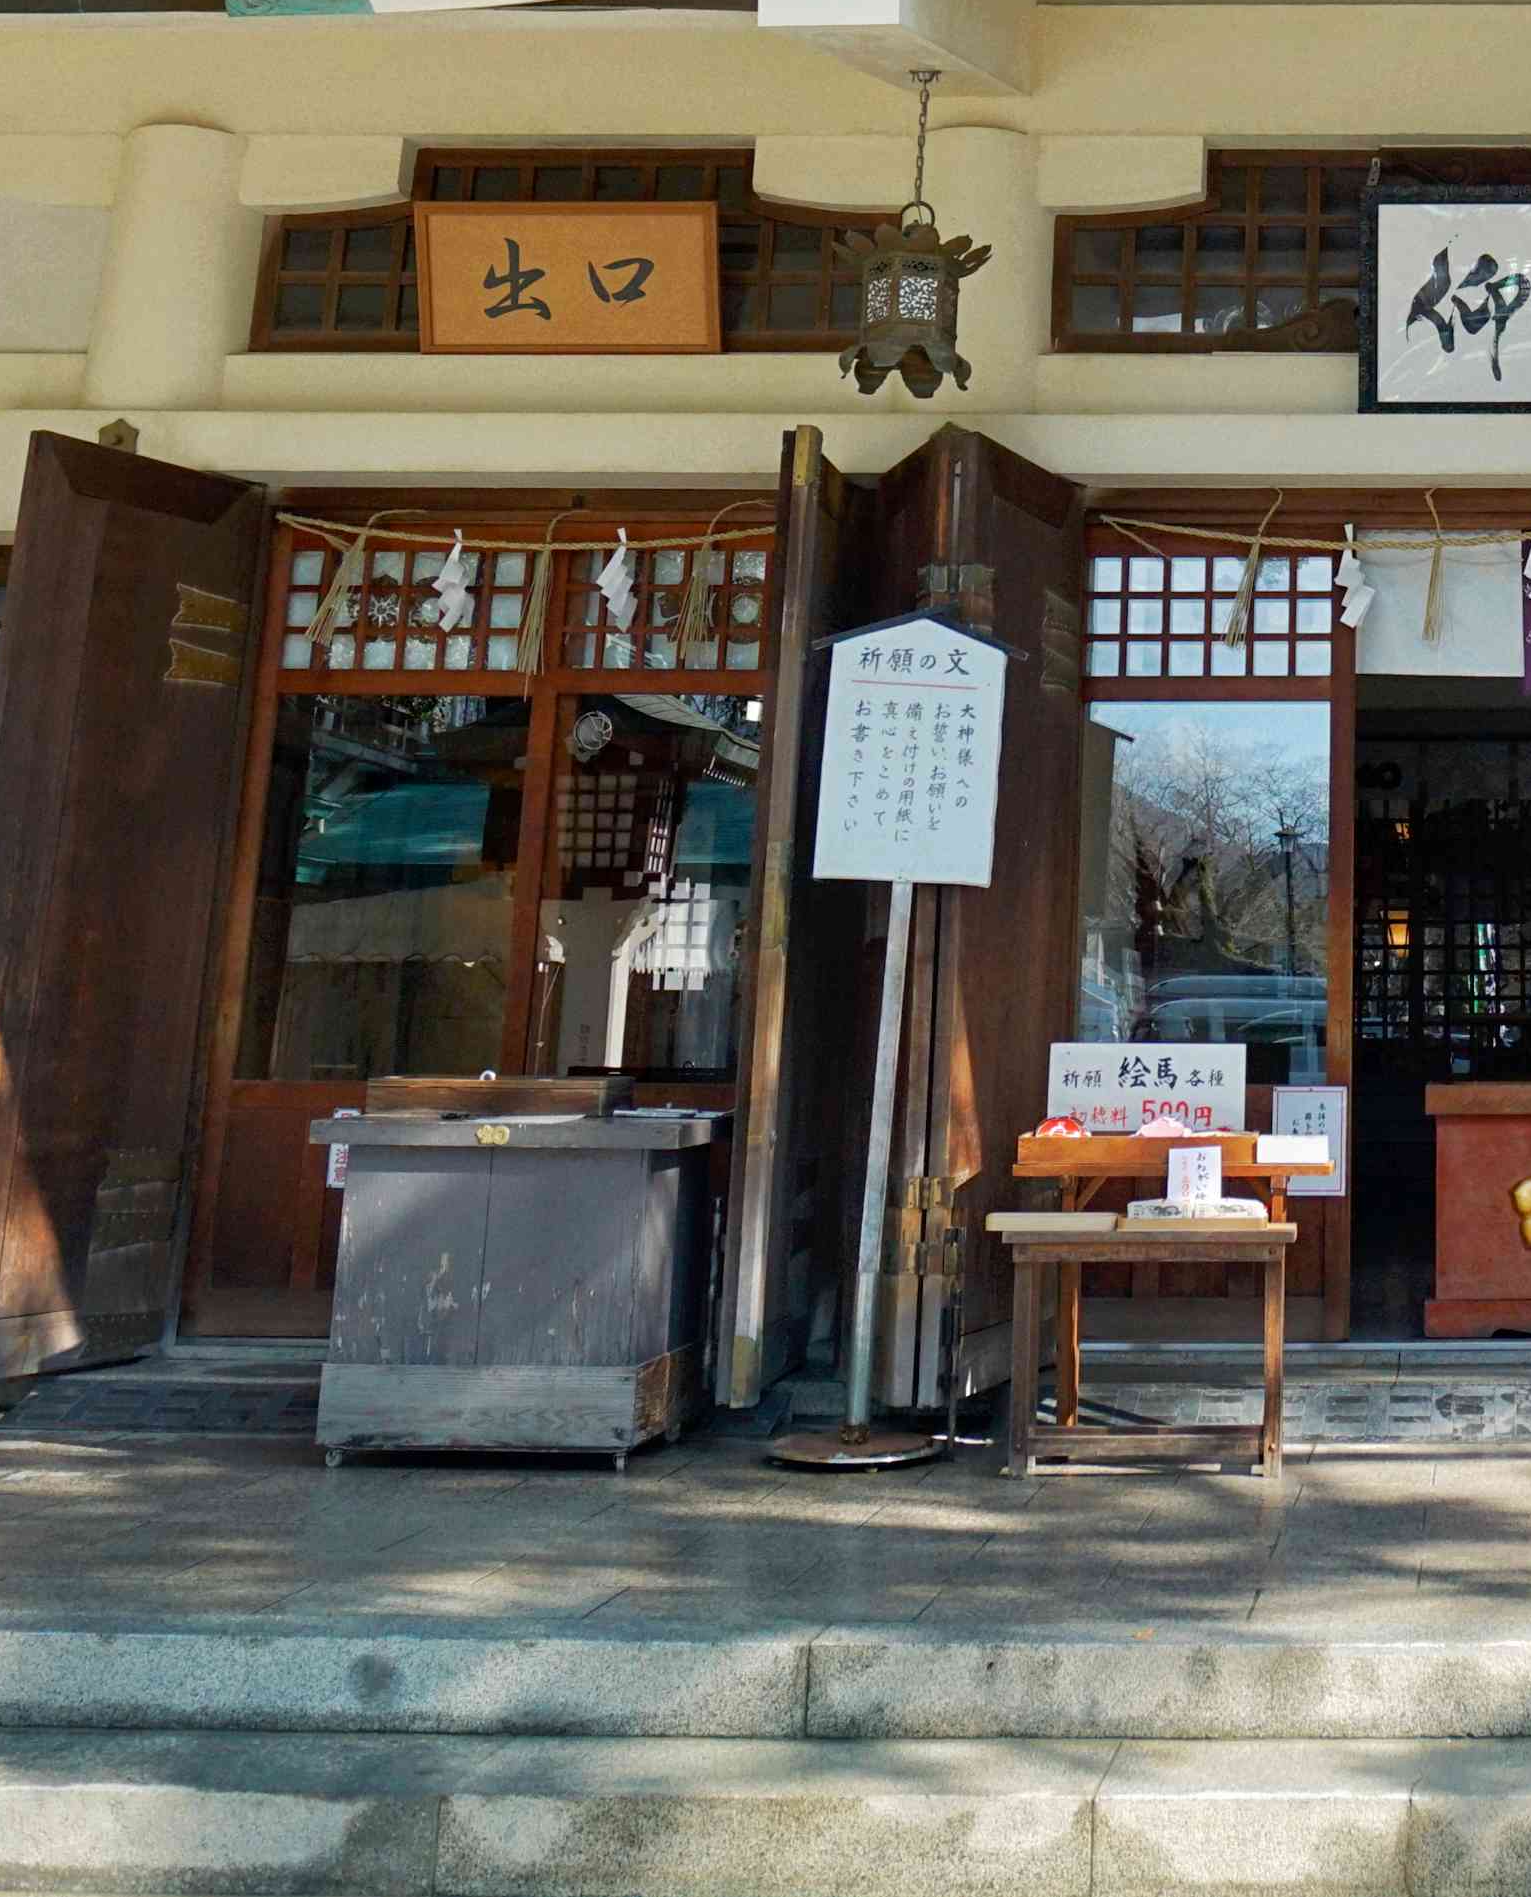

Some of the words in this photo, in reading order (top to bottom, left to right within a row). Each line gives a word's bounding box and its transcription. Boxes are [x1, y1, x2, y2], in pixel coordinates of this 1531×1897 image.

[483, 238, 654, 320] 出口
[858, 648, 970, 676] 祈願の文
[844, 700, 871, 832] お書き下さい
[873, 702, 899, 826] 真心をこめて
[894, 702, 925, 842] 備え付けの用紙に
[955, 703, 977, 808] 大神様への
[1062, 1068, 1102, 1087] 祈願
[1118, 1055, 1178, 1089] 絵馬
[1185, 1068, 1225, 1087] 各種
